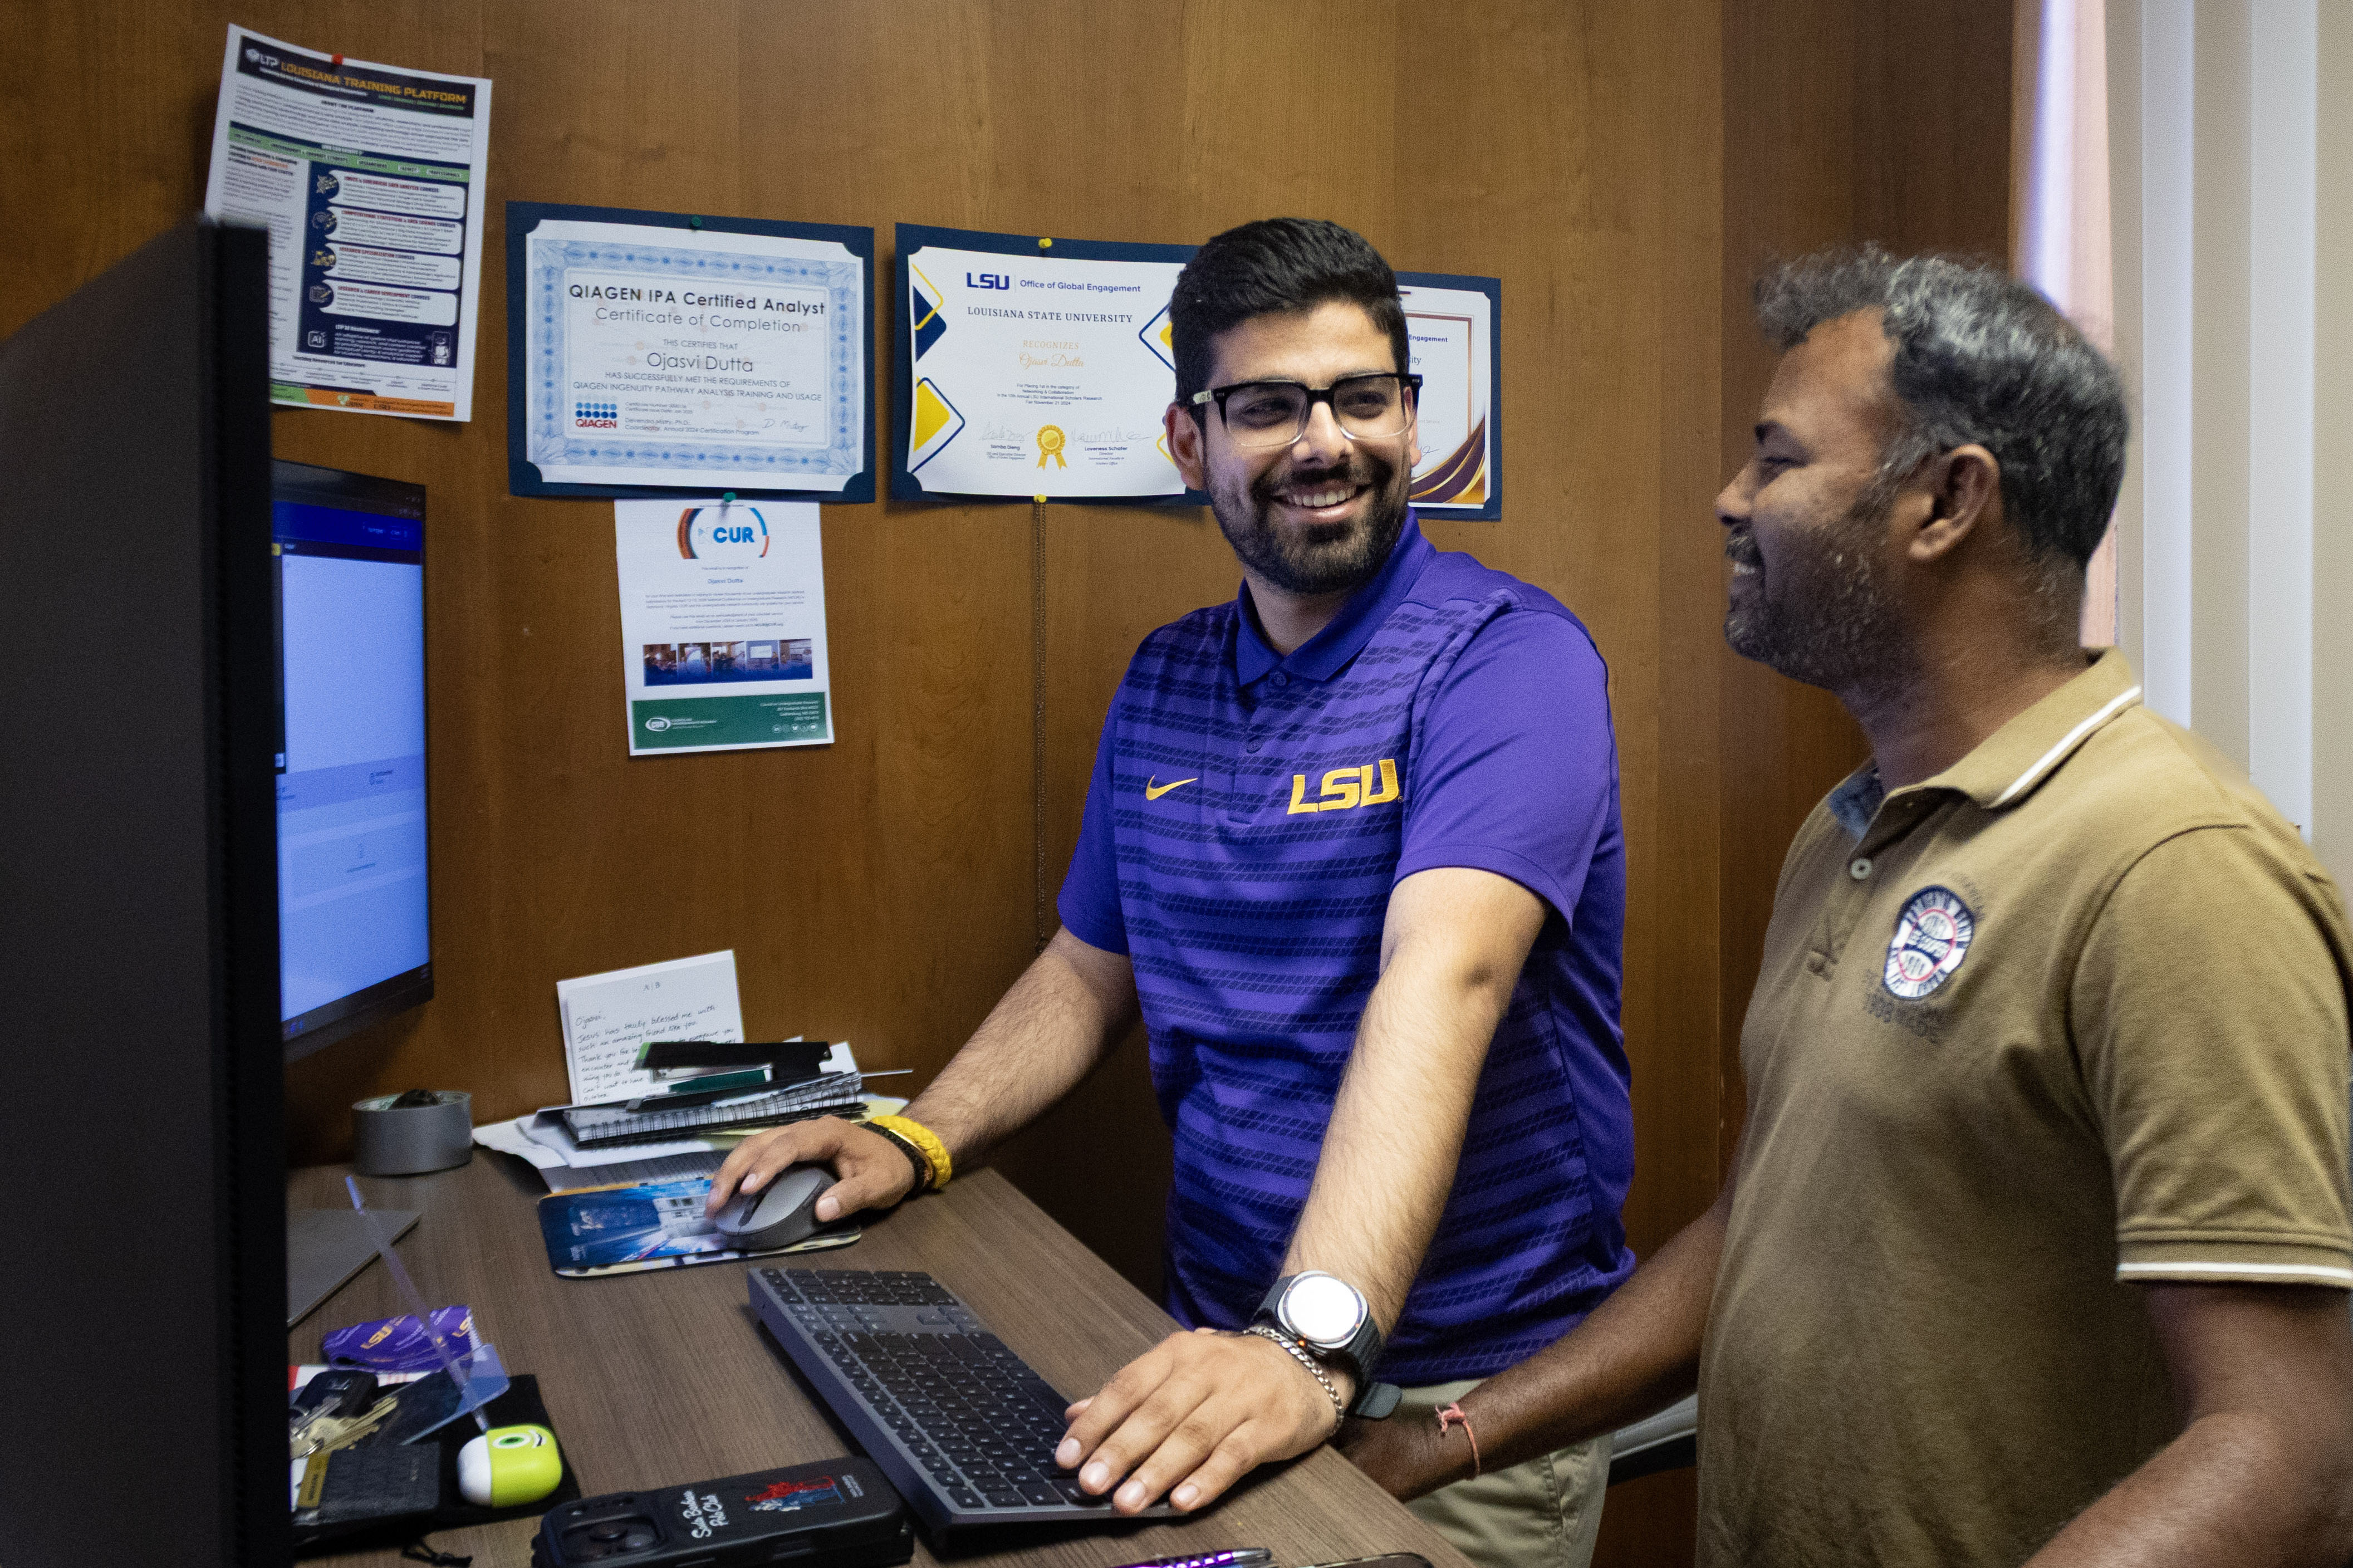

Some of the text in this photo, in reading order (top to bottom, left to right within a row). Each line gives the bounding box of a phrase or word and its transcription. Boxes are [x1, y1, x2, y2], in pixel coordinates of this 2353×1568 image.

[281, 62, 341, 84] LOUISIANA
[344, 76, 401, 95] TRAINING
[404, 87, 467, 104] PLATFORM
[967, 272, 1009, 291] LSU
[1020, 280, 1045, 288] Office
[1057, 282, 1084, 291] Global
[1087, 283, 1141, 293] Engagement
[570, 285, 825, 316] QIAGEN IPA Certified Analyst
[595, 307, 800, 332] Certificate of Completion
[968, 307, 1133, 323] LOUISIANA STATE UNIVERSITY
[680, 340, 717, 349] CERTIFIES
[1023, 340, 1079, 350] RECOGNIZES
[647, 352, 753, 372] Ojasvi Dutta
[573, 381, 607, 390] QIAGEN
[610, 384, 653, 392] INGENUITY
[655, 386, 694, 394] PATHWAY
[697, 389, 734, 397] ANALYSIS
[737, 390, 773, 399] TRAINING
[624, 373, 683, 383] SUCCESSFULLY
[719, 378, 777, 388] REQUIREMENTS
[575, 419, 617, 428] QIAGEN
[1287, 758, 1399, 815] LSU
[577, 1032, 599, 1043] Jesus
[651, 1012, 678, 1025] blessed
[698, 1005, 715, 1015] with
[579, 1043, 595, 1052] such
[612, 1034, 643, 1044] amazing
[579, 1054, 601, 1062] Thank
[360, 1325, 393, 1349] LSU
